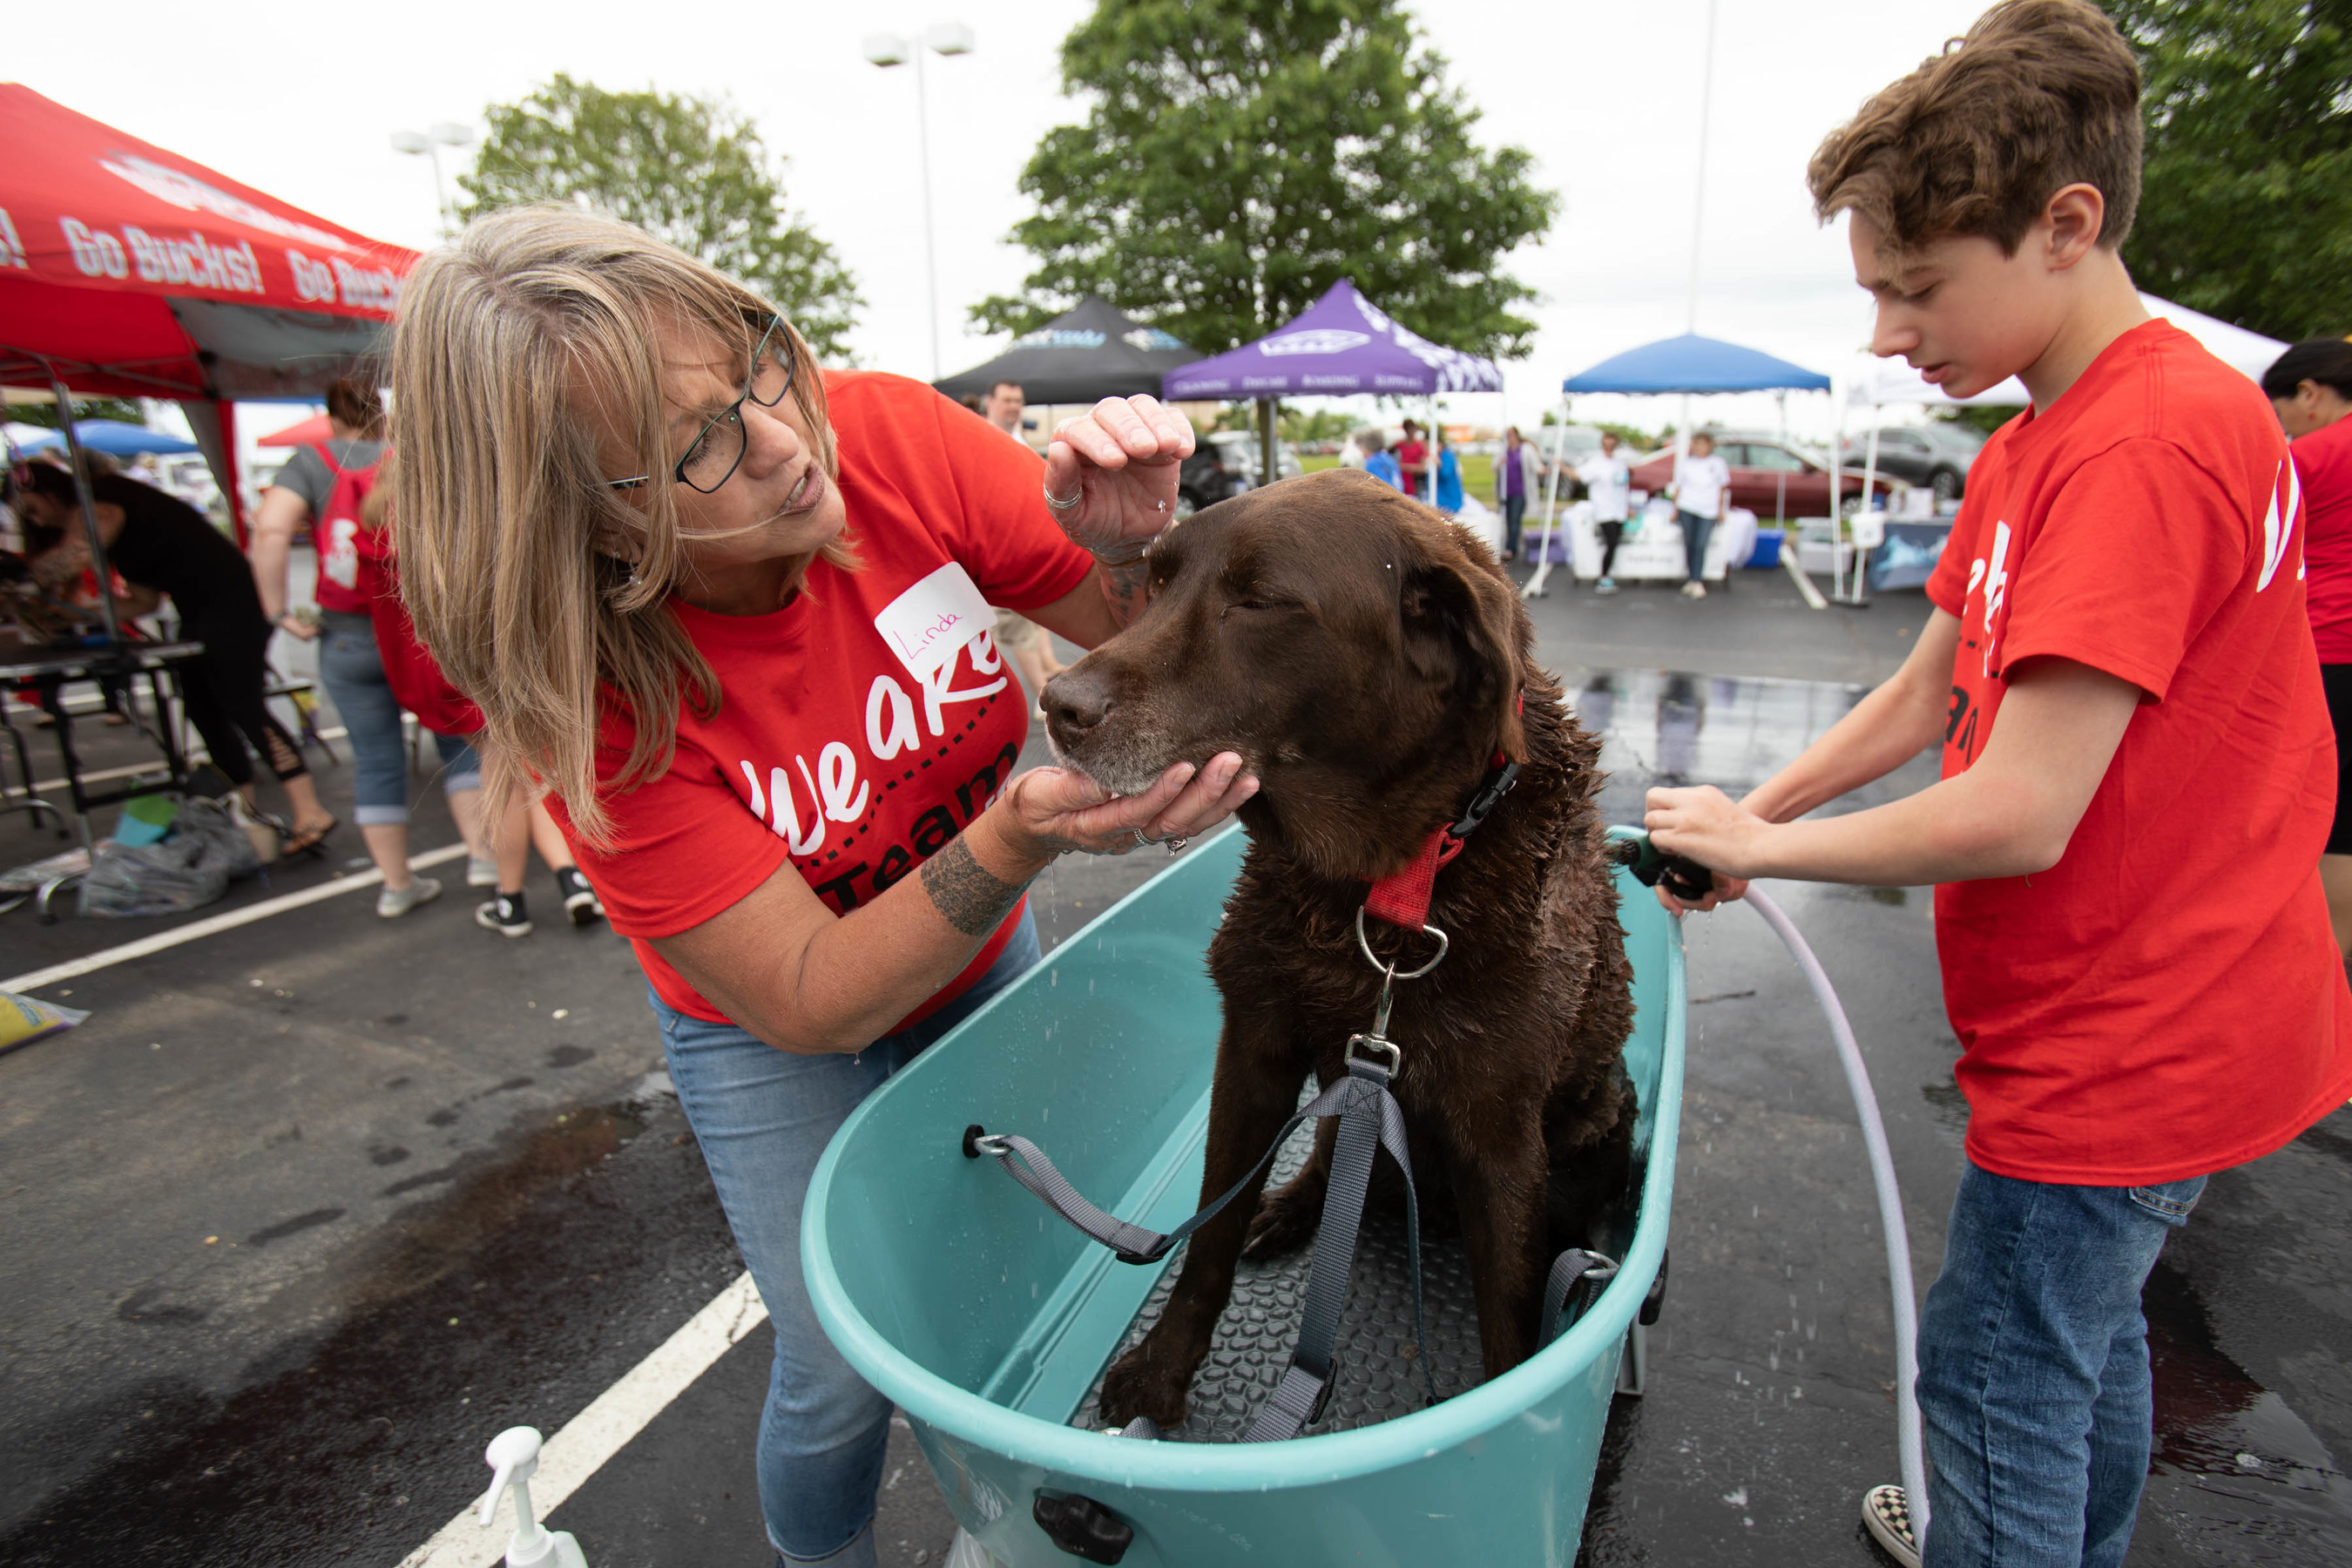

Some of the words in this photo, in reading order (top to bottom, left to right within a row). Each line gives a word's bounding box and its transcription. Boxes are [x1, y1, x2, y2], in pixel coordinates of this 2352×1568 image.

[60, 216, 129, 280] Go
[121, 225, 266, 294] Bucks!
[287, 249, 337, 303] Go
[893, 613, 963, 660] Linda
[740, 740, 869, 855] We
